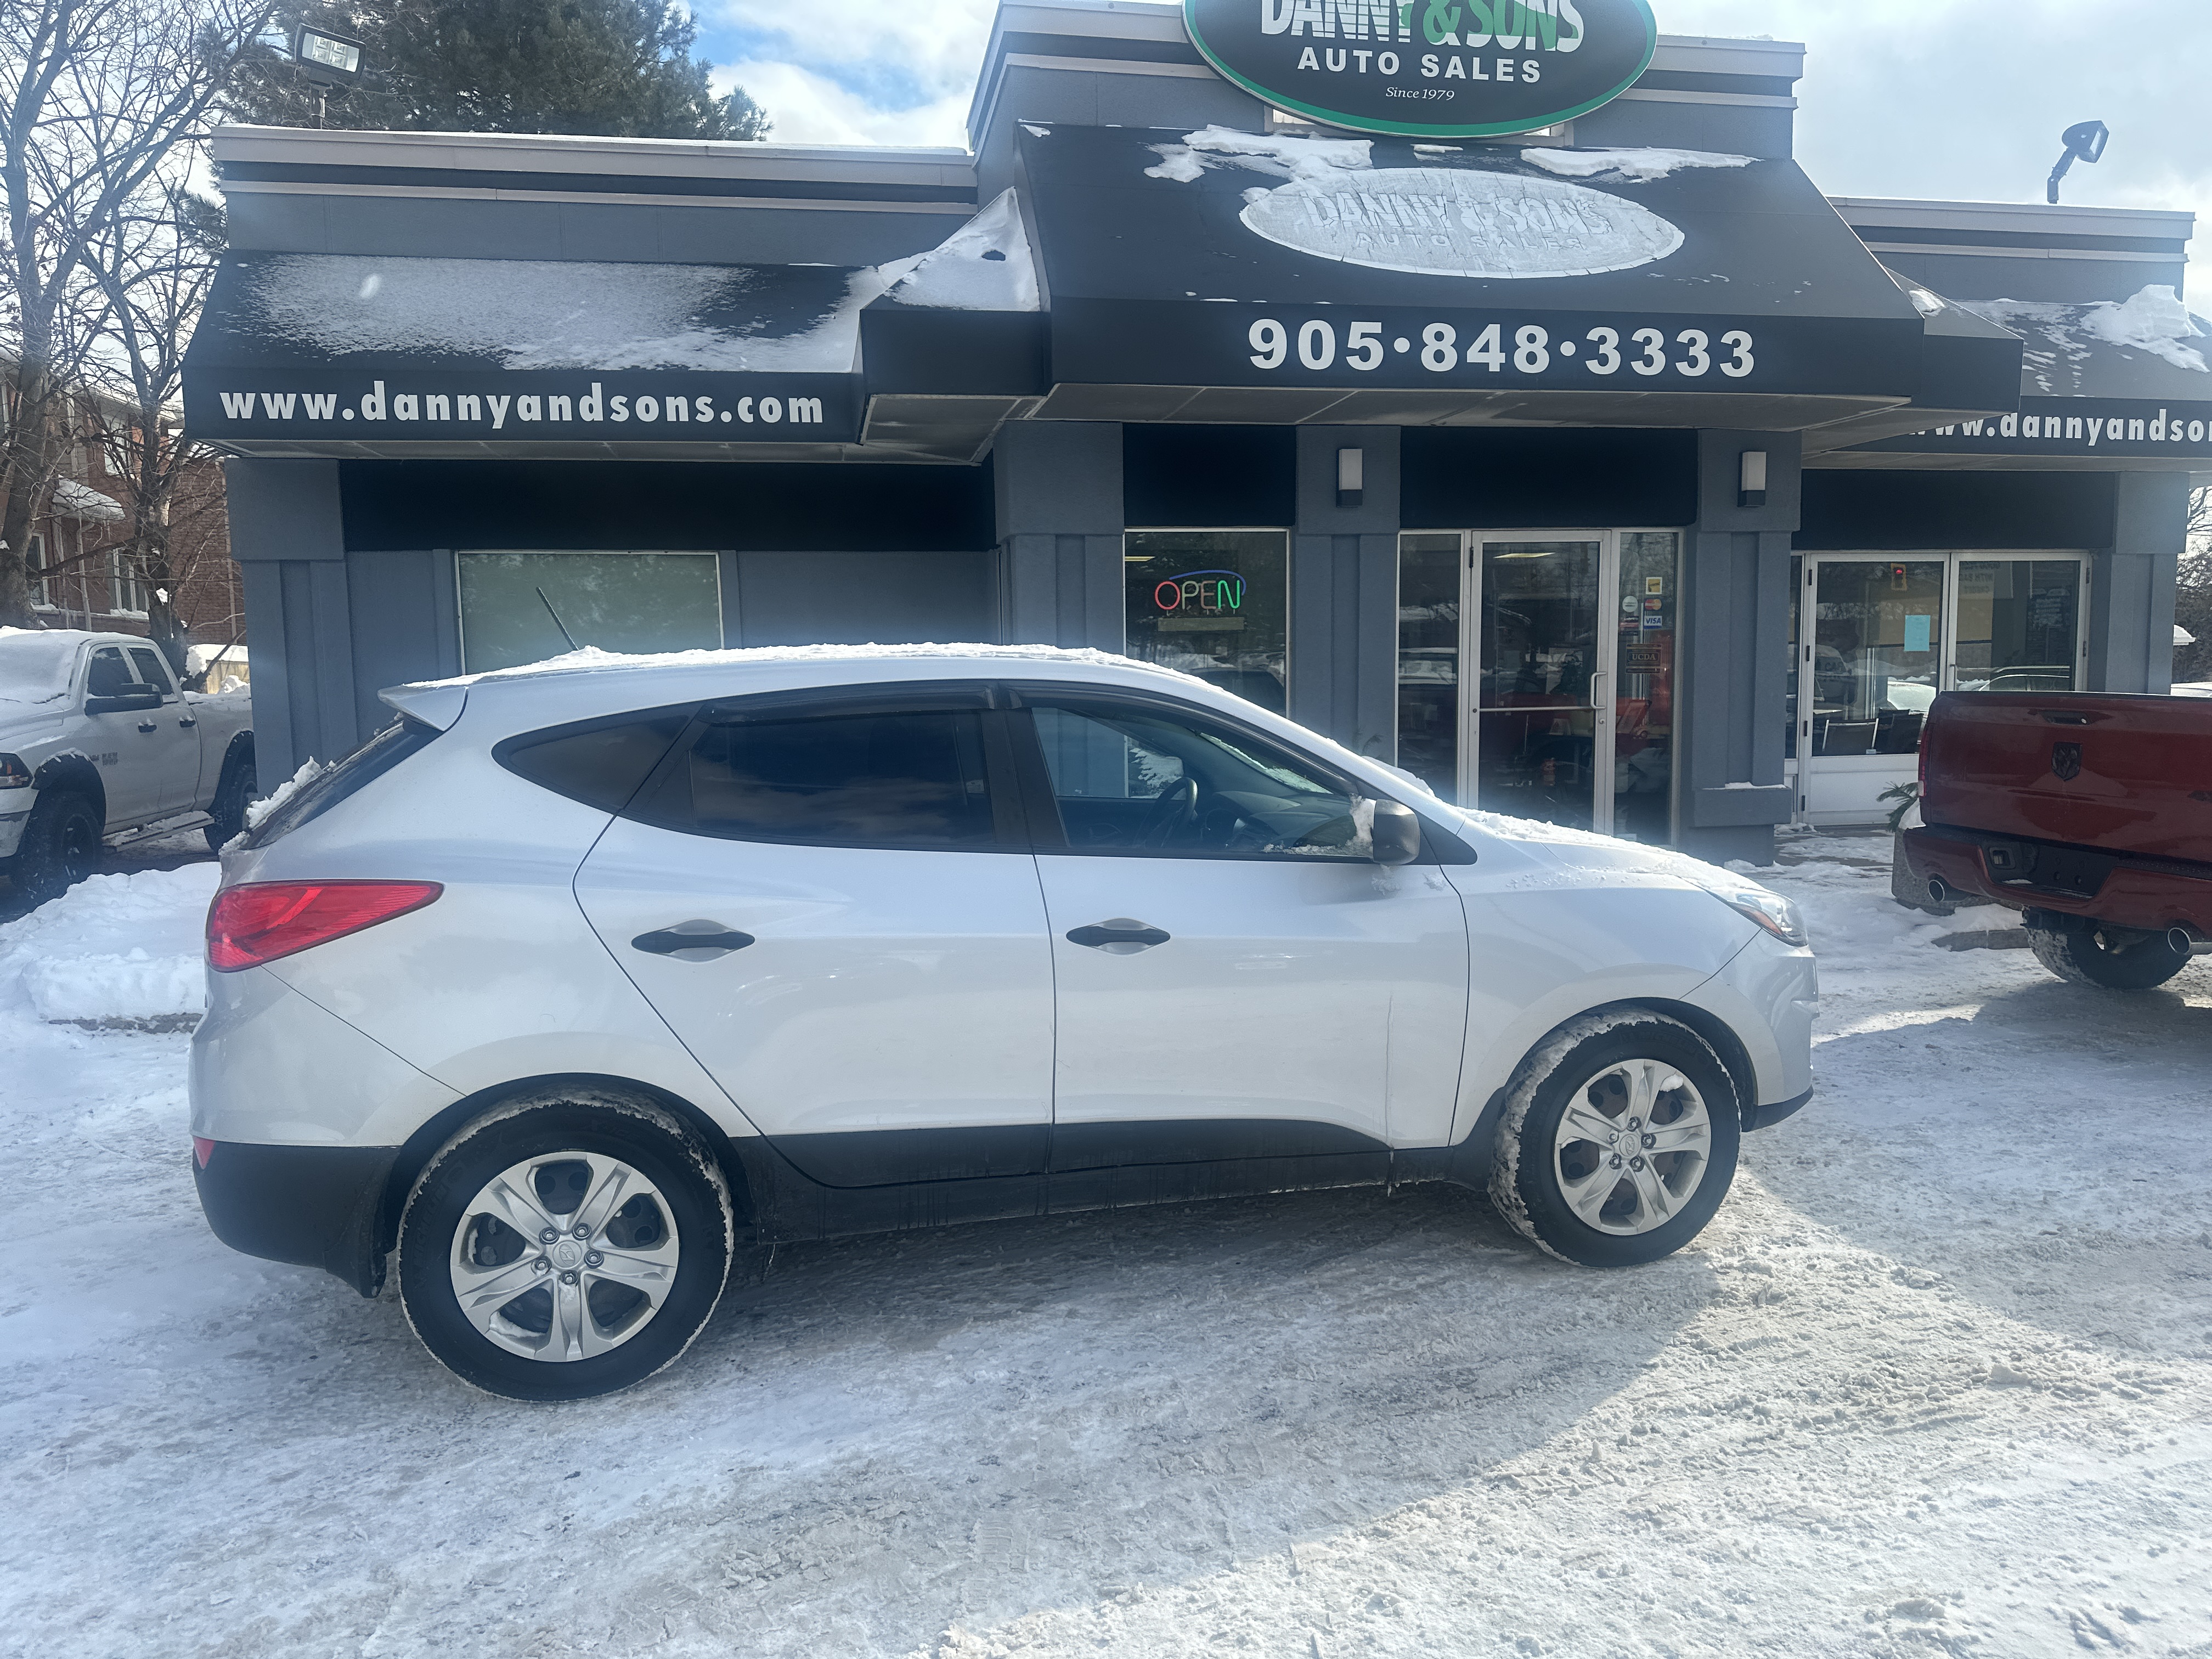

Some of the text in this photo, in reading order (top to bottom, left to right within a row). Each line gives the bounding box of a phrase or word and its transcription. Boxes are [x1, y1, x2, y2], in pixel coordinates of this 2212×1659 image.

[1262, 0, 1415, 43] DANNY
[1466, 0, 1585, 53] SONS
[1297, 47, 1541, 83] AUTO SALES
[1386, 86, 1455, 101] Since 1979
[1300, 191, 1452, 231] DANNY
[1494, 196, 1613, 236] SONS
[218, 380, 824, 430] www.dannyandsons.com
[1909, 408, 2212, 447] w.dannyandso
[1154, 579, 1240, 611] OPEN
